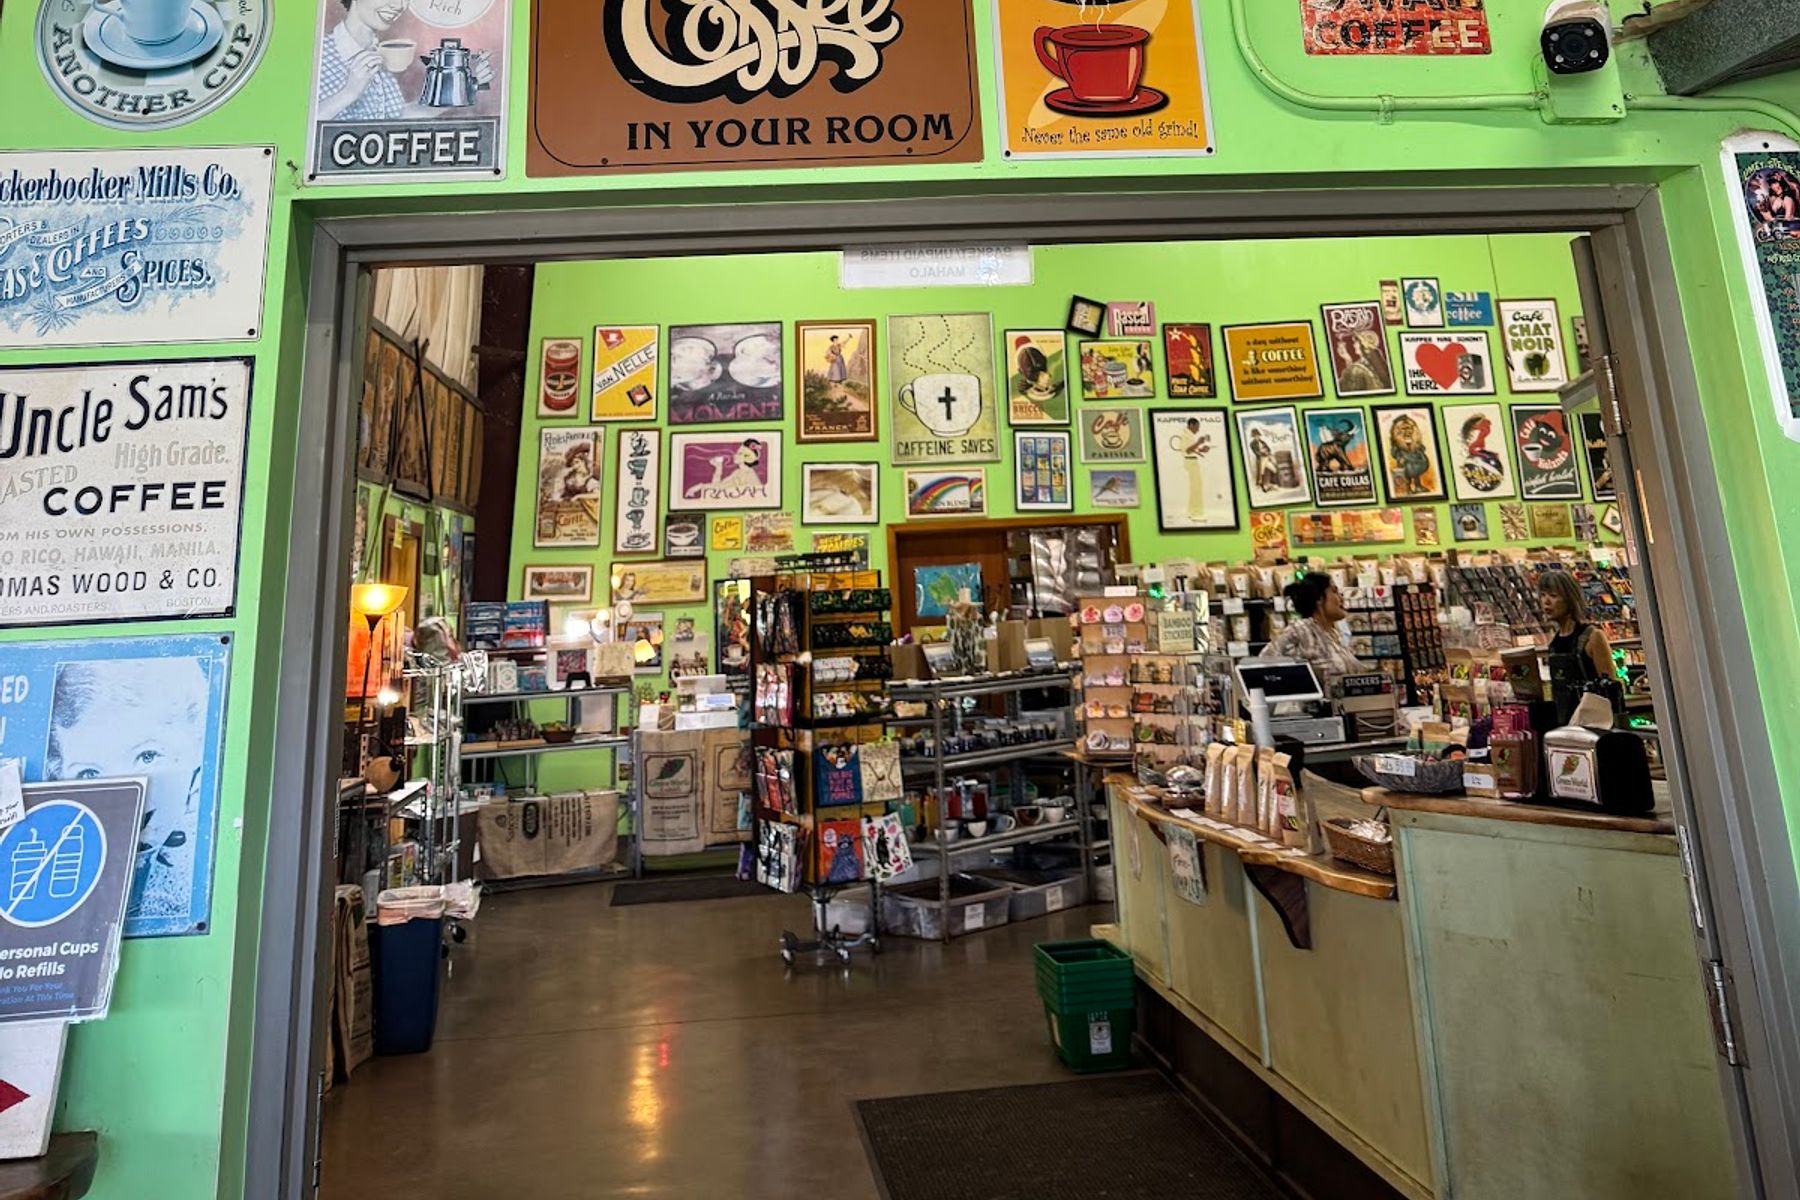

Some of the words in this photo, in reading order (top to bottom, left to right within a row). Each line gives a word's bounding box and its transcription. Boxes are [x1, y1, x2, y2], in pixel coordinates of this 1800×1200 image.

[1311, 18, 1484, 50] COFFEE
[51, 21, 197, 114] ANOTHER
[202, 22, 254, 91] CUP
[626, 122, 672, 151] IN
[688, 117, 812, 148] YOUR
[825, 113, 955, 145] ROOM
[1021, 126, 1064, 145] Never
[1069, 125, 1091, 145] the
[1094, 127, 1128, 142] same
[1132, 119, 1153, 137] old
[332, 129, 480, 166] COFFEE
[134, 164, 199, 200] Mills
[203, 163, 241, 200] Co.
[47, 217, 151, 284] COFFEES
[1113, 304, 1151, 334] Rascal
[1511, 310, 1544, 322] Café
[1508, 323, 1552, 337] CHAT
[1261, 348, 1305, 362] COFFEE
[1511, 338, 1555, 351] NOIR
[595, 375, 614, 389] VAN
[612, 343, 656, 382] NELLE
[1409, 368, 1426, 378] IHR
[1411, 379, 1439, 390] HERZ
[0, 390, 114, 460] Uncle
[124, 374, 229, 431] Sam's
[670, 401, 781, 422] MOMENT
[114, 442, 163, 474] High
[166, 440, 232, 467] Grade.
[896, 439, 955, 458] CAFFEINE
[961, 438, 995, 454] SAVES
[43, 480, 227, 516] COFFEE
[25, 530, 50, 540] HIS
[56, 528, 96, 539] OWN
[101, 522, 208, 537] POSSESSIONS.
[72, 571, 148, 594] WOOD
[159, 569, 175, 590] &
[187, 567, 222, 588] CO.
[1162, 617, 1192, 630] BAMBOO
[1162, 629, 1194, 642] STICKERS
[1344, 676, 1380, 687] STICKERS
[60, 941, 99, 957] Cups
[16, 961, 66, 979] Refills
